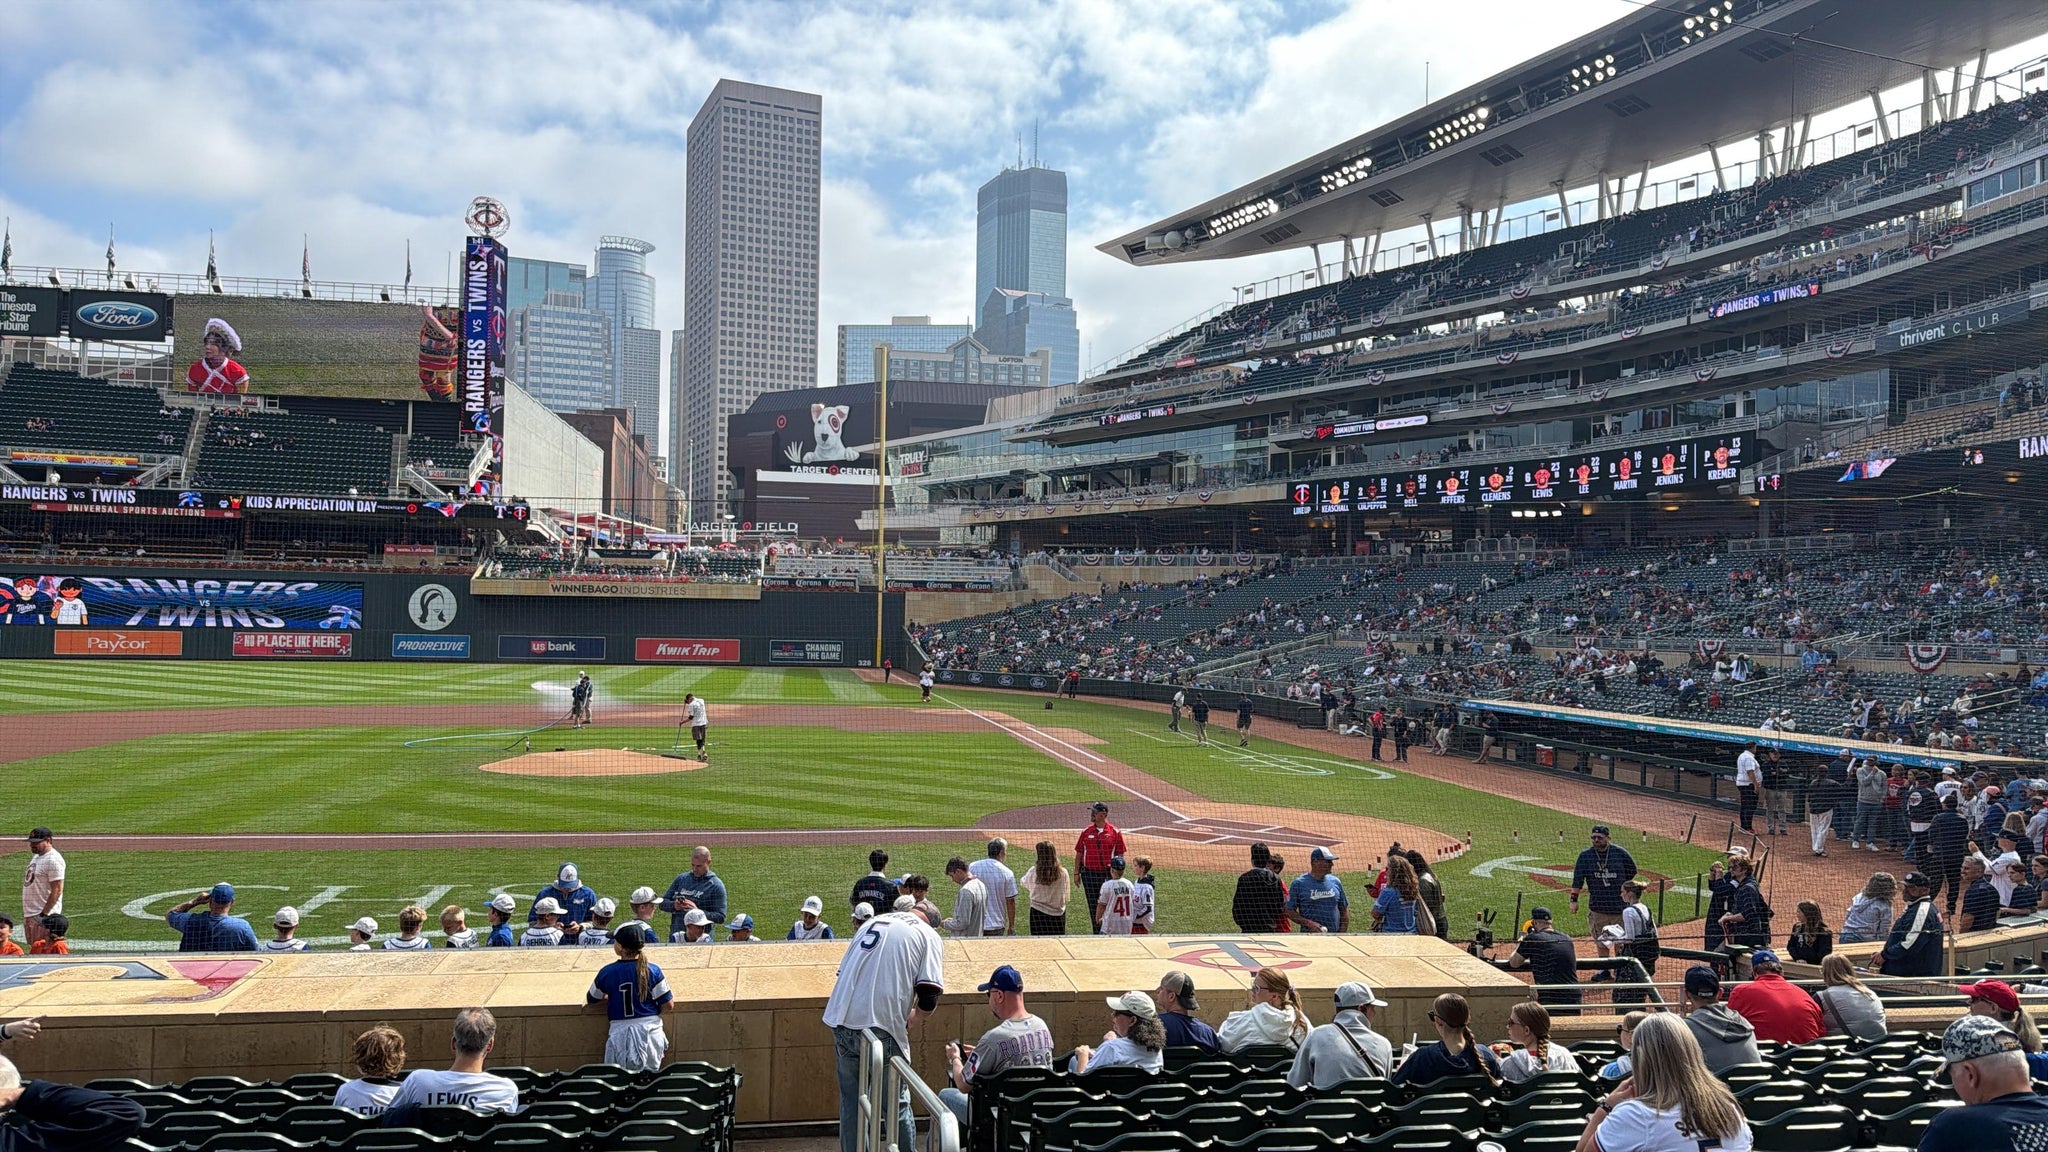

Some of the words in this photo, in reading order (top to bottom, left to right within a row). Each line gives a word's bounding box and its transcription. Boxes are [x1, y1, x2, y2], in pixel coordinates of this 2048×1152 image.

[468, 260, 488, 313] TWINS
[1, 292, 17, 302] The
[1722, 295, 1759, 314] RANGERS
[1773, 284, 1801, 303] TWINS
[9, 312, 31, 323] Star
[93, 304, 141, 325] Ford
[1900, 324, 1946, 347] thrivent
[1952, 312, 2000, 334] CLUB
[1300, 332, 1312, 343] END
[1313, 328, 1336, 340] RACISM
[466, 339, 486, 412] RANGERS
[1119, 411, 1142, 422] RANGERS
[1148, 408, 1164, 418] TWINS
[1334, 425, 1361, 434] COMMUNITY
[1362, 423, 1375, 431] FUND
[1732, 437, 1741, 448] 13
[1681, 445, 1688, 454] 11
[899, 451, 924, 465] TRULY
[1591, 457, 1600, 466] 22
[1634, 451, 1642, 461] 16
[1704, 450, 1711, 462] P
[1551, 462, 1560, 471] 23
[1609, 463, 1616, 473] 8
[1652, 457, 1659, 468] 9
[790, 466, 828, 474] TARGET
[840, 467, 878, 476] CENTER
[1460, 470, 1469, 480] 27
[1509, 466, 1514, 475] 2
[1569, 468, 1574, 478] 7
[1708, 468, 1737, 481] KREMER
[1480, 476, 1486, 486] 5
[1525, 472, 1531, 483] 6
[1654, 473, 1684, 486] JENKINS
[1343, 481, 1350, 489] 15
[1396, 484, 1401, 493] 3
[1436, 480, 1442, 490] 4
[1579, 484, 1589, 494] LEE
[1613, 479, 1638, 491] MARTIN
[2, 486, 68, 500] RANGERS
[91, 489, 136, 504] TWINS
[1322, 490, 1327, 499] 1
[1358, 487, 1363, 496] 2
[1481, 491, 1511, 502] CLEMENS
[1532, 489, 1553, 498] LEWIS
[246, 496, 273, 509] KIDS
[274, 497, 355, 512] APPRECIATION
[356, 500, 378, 514] DAY
[1440, 495, 1466, 504] JEFFERS
[67, 503, 118, 514] UNIVERSAL
[123, 506, 157, 516] SPORTS
[162, 508, 206, 517] AUCTIONS
[1293, 506, 1311, 515] LINEUP
[1321, 504, 1349, 513] KEASCHALL
[683, 522, 738, 531] TARGET
[756, 522, 798, 531] FIELD
[83, 576, 318, 600] RANGERS
[763, 578, 789, 587] Corona
[796, 578, 821, 587] Corona
[829, 579, 854, 588] Corona
[887, 580, 913, 588] Corona
[926, 581, 952, 589] Corona
[551, 584, 618, 593] WINNEBAGO
[620, 585, 687, 595] INDUSTRIES
[125, 604, 286, 627] TWINS
[87, 636, 150, 652] Paycor
[257, 634, 293, 648] PLACE
[295, 635, 311, 647] LIKE
[313, 636, 341, 648] HERE
[397, 640, 465, 652] PROGRESSIVE
[531, 642, 546, 652] us
[548, 640, 577, 652] bank
[805, 643, 841, 651] CHANGING
[806, 651, 819, 660] THE
[820, 652, 841, 660] GAME
[858, 890, 885, 900] TAIWANESE
[1113, 887, 1130, 895] RYAN
[1113, 895, 1131, 917] 41
[860, 921, 890, 952] 5
[619, 982, 634, 1018] 1
[427, 1092, 479, 1109] LEWIS
